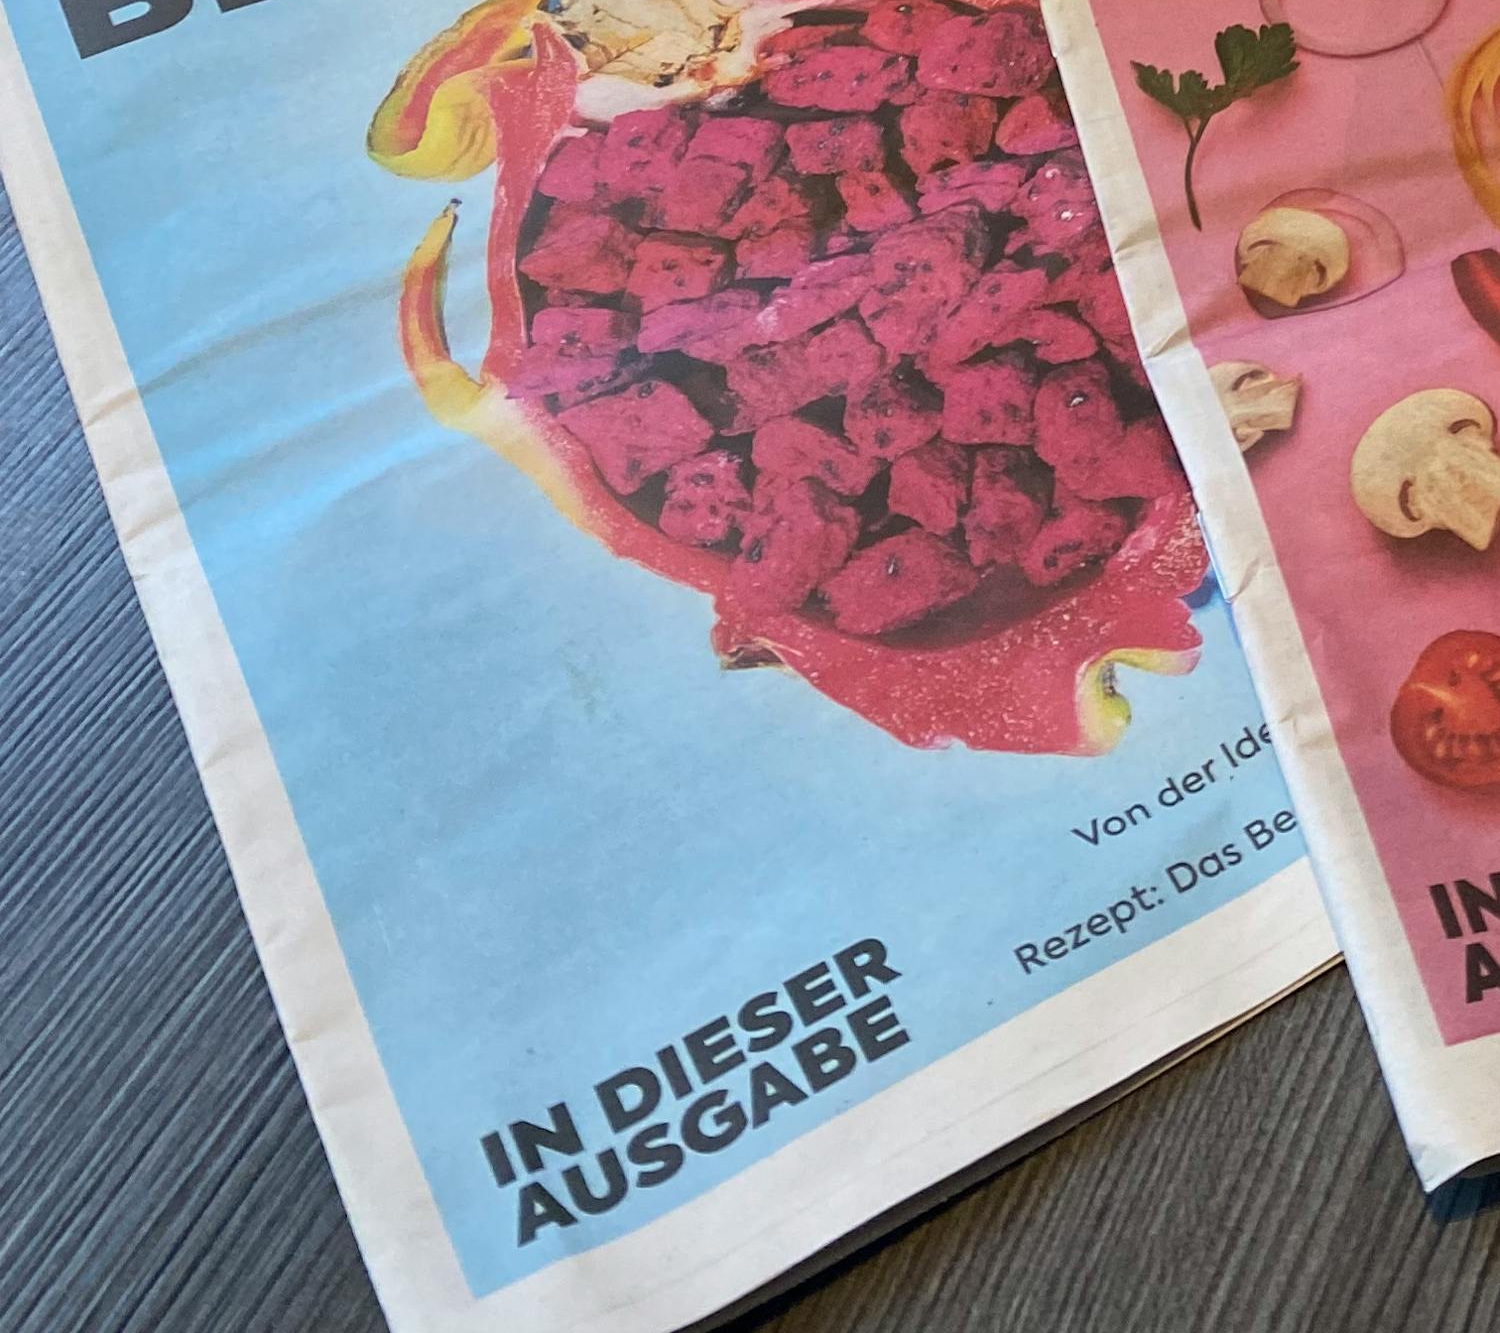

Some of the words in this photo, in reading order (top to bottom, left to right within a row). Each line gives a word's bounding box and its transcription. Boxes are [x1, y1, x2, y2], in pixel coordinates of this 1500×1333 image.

[1013, 884, 1165, 975] Rezept:
[1165, 842, 1243, 894] Das
[1243, 808, 1298, 851] Be
[1071, 802, 1152, 846] Von
[1157, 758, 1216, 808] der
[481, 1101, 584, 1190] IN
[593, 937, 902, 1136] DIESER
[515, 994, 911, 1249] AUSGABE
